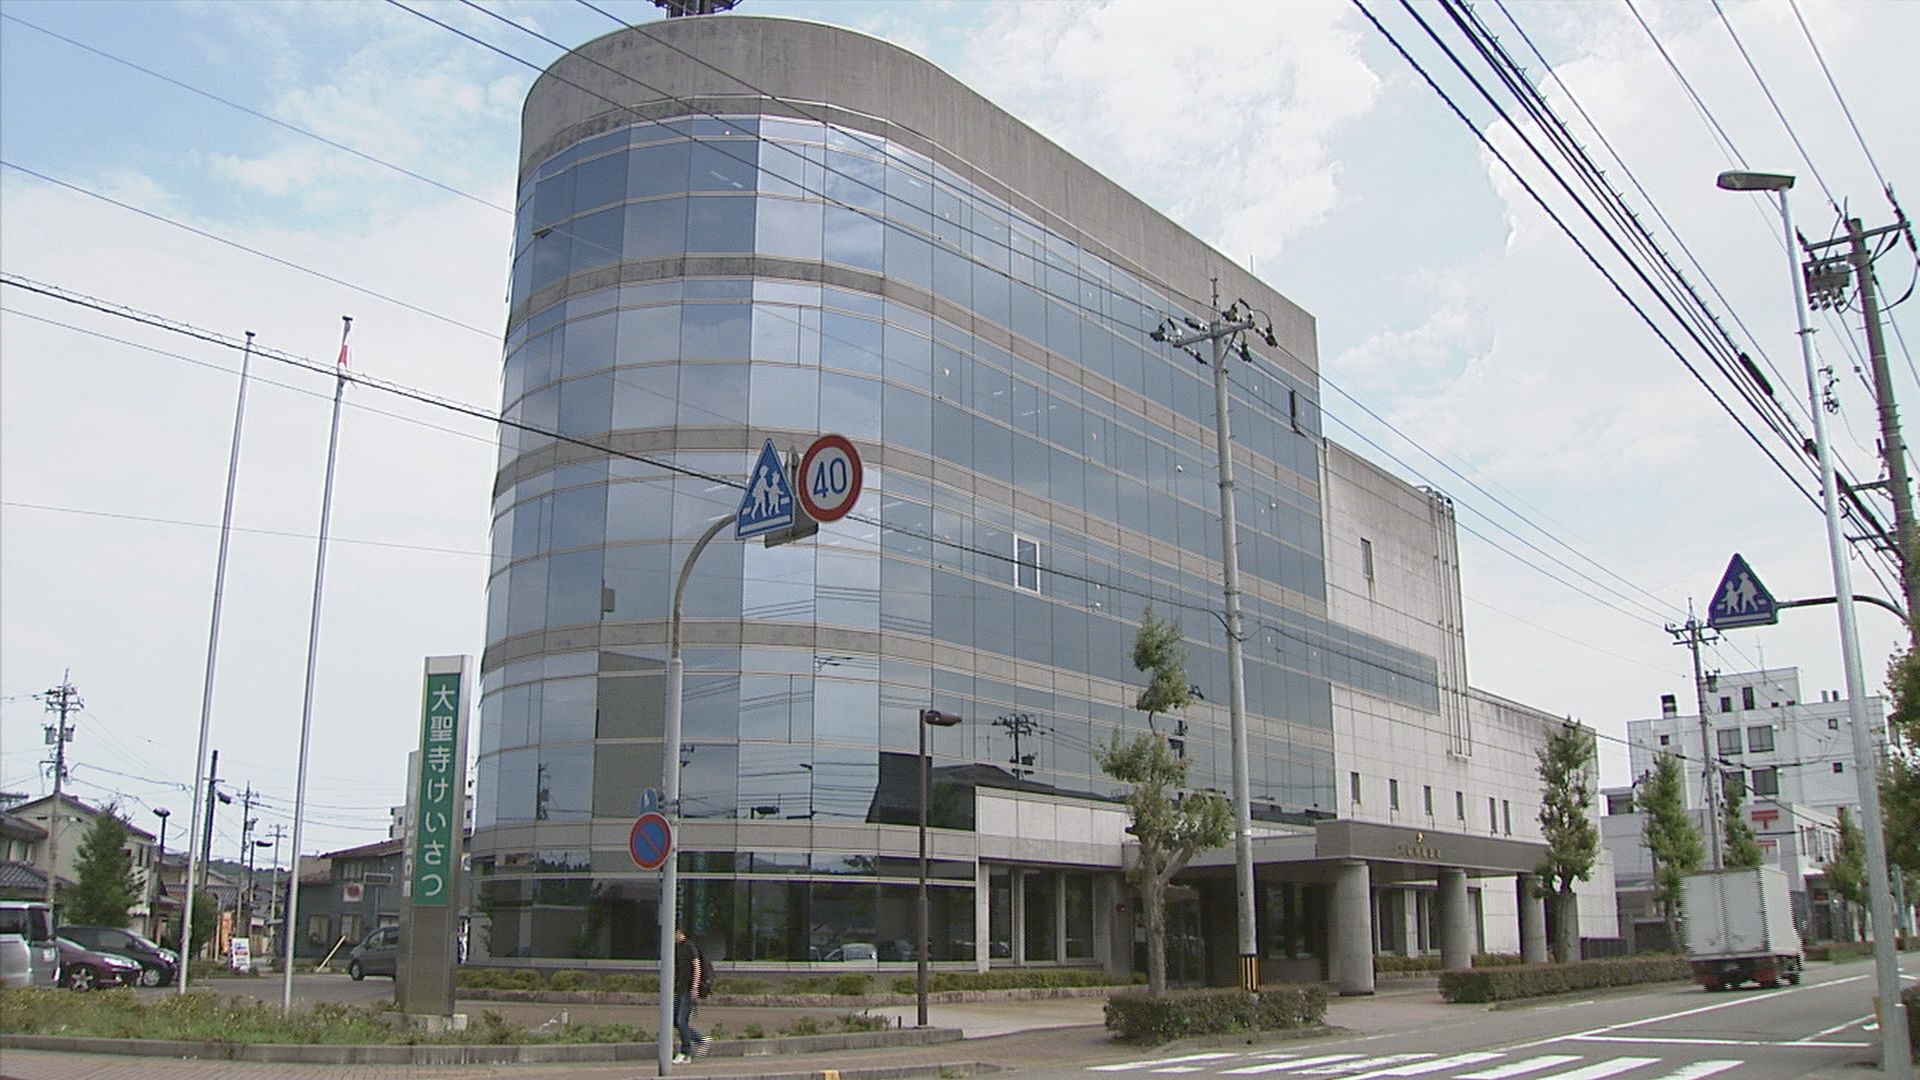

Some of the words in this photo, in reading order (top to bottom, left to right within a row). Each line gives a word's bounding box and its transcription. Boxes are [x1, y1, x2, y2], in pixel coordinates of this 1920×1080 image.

[813, 457, 847, 498] 40
[421, 684, 455, 896] 大聖寺けいさつ
